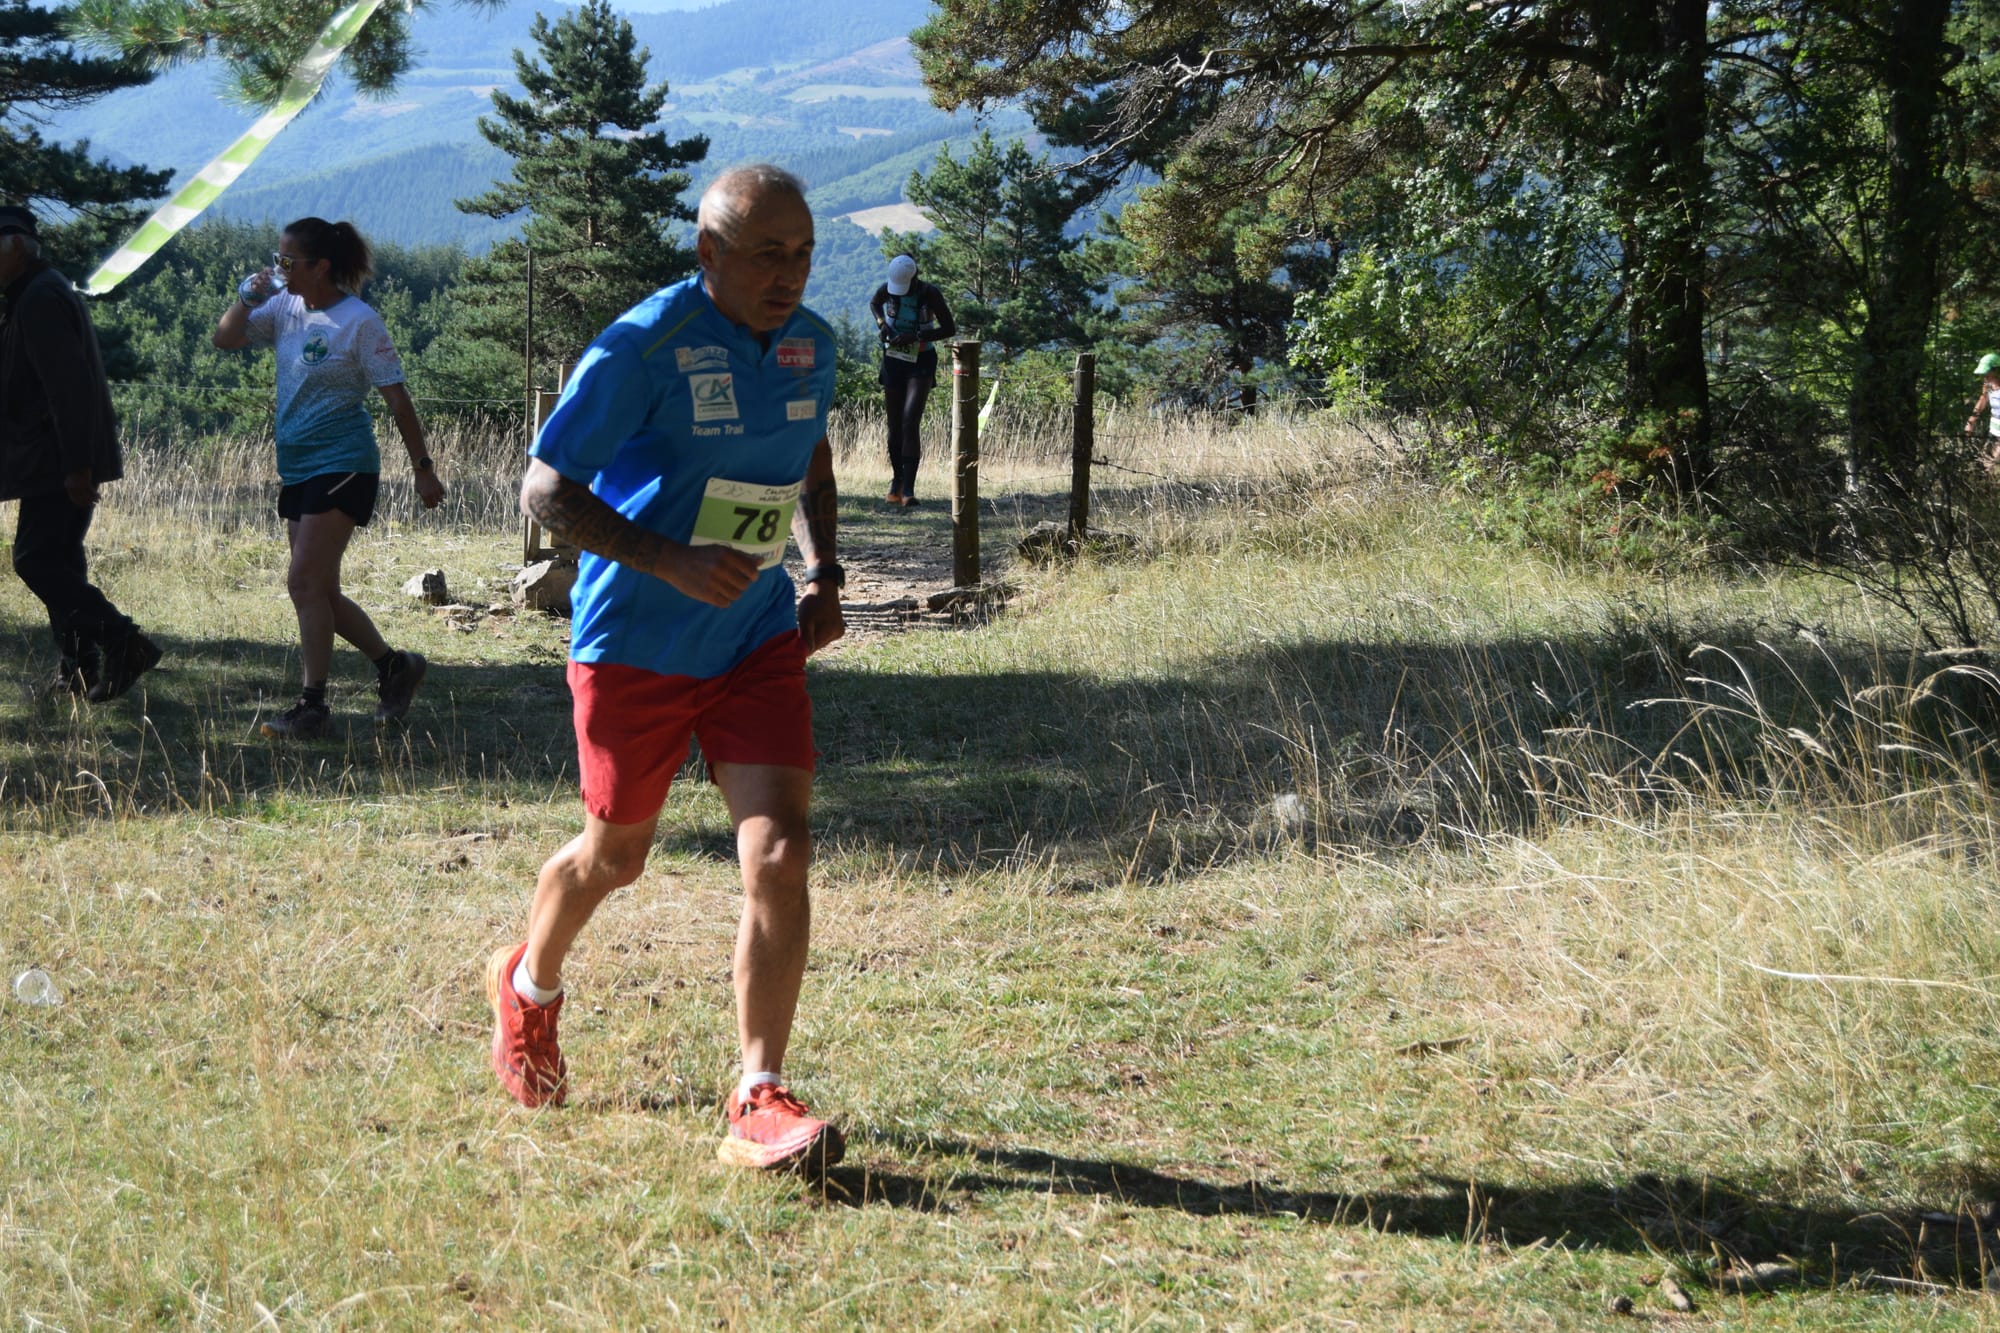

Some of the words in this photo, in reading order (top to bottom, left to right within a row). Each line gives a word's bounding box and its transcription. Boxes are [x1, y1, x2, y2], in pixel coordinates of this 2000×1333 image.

[692, 425, 721, 437] Team
[724, 423, 745, 435] Trail
[732, 506, 781, 543] 78
